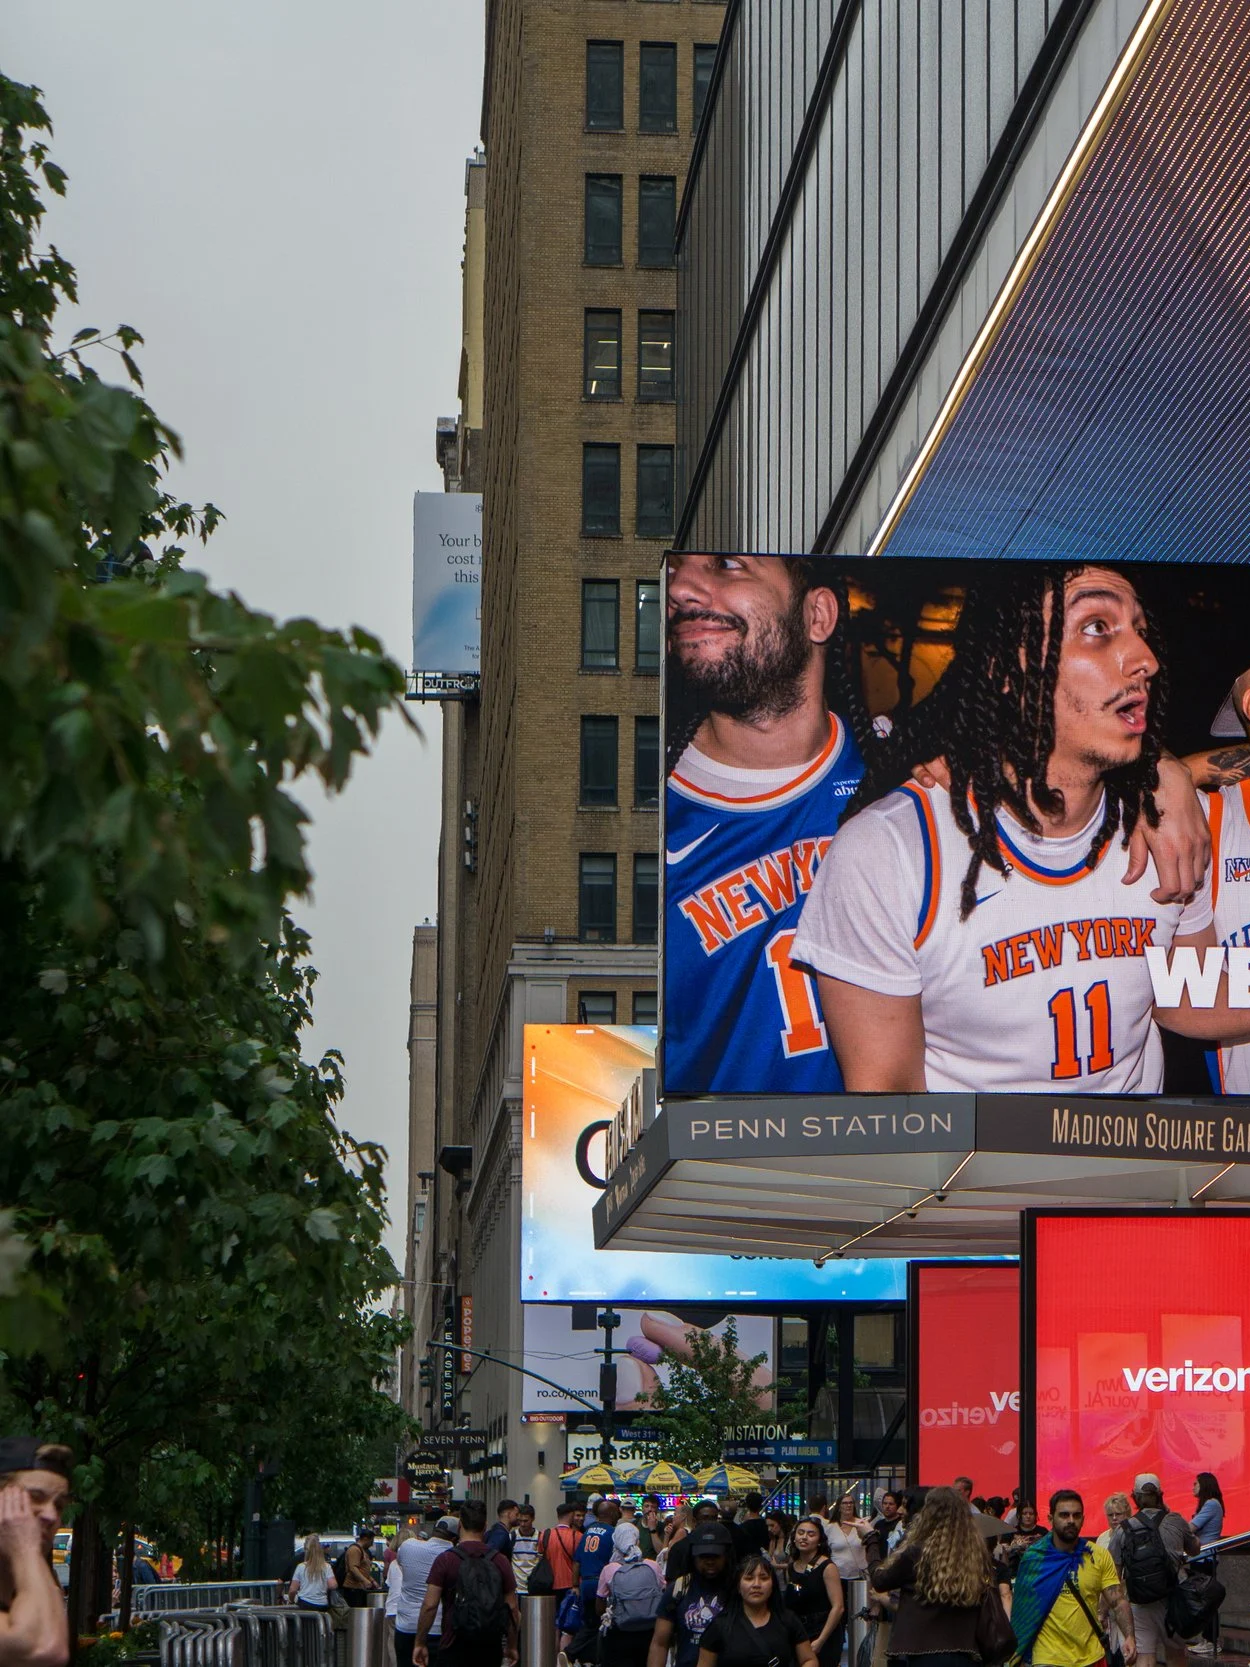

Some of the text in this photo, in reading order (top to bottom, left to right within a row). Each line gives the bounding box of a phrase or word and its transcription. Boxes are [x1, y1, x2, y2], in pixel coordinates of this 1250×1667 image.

[439, 534, 470, 547] Your
[447, 554, 474, 565] cost
[455, 570, 479, 583] this
[981, 926, 1067, 988] NEW
[1047, 979, 1115, 1081] 11
[691, 1112, 953, 1141] PENN STATION
[1052, 1108, 1138, 1147] MADISON
[1145, 1113, 1216, 1152] SQUARE
[444, 1332, 453, 1378] EASE
[537, 1388, 598, 1399] ro.co/penn
[621, 1429, 640, 1438] West
[736, 1425, 787, 1440] STATION
[424, 1435, 485, 1445] SEVEN PENN
[781, 1446, 797, 1456] PLAN
[407, 1462, 439, 1472] Mustang
[584, 1534, 600, 1553] 10
